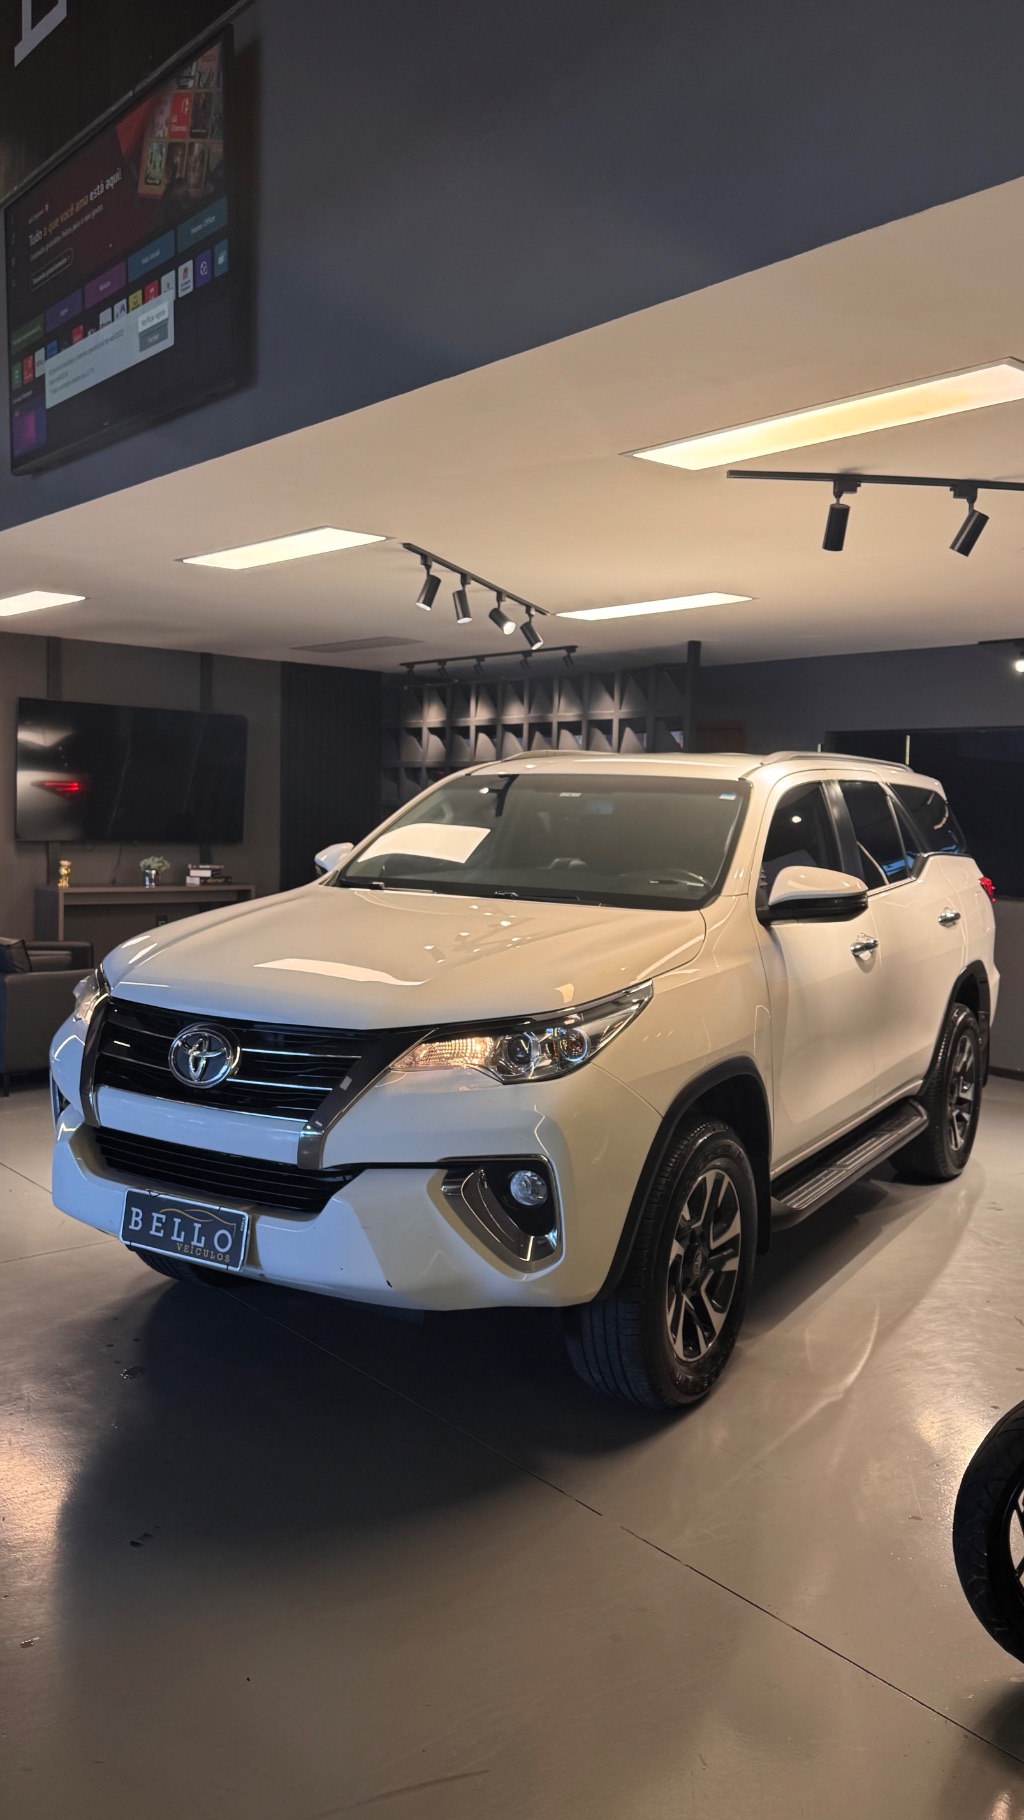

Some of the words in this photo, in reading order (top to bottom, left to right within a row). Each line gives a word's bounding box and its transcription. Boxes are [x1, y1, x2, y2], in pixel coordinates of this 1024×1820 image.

[29, 230, 43, 246] Tudo
[48, 218, 60, 235] que
[60, 204, 75, 223] você
[75, 195, 89, 212] ama
[89, 180, 105, 201] está
[105, 168, 122, 190] aqui!
[203, 215, 216, 228] Office
[128, 1207, 233, 1253] BELLO
